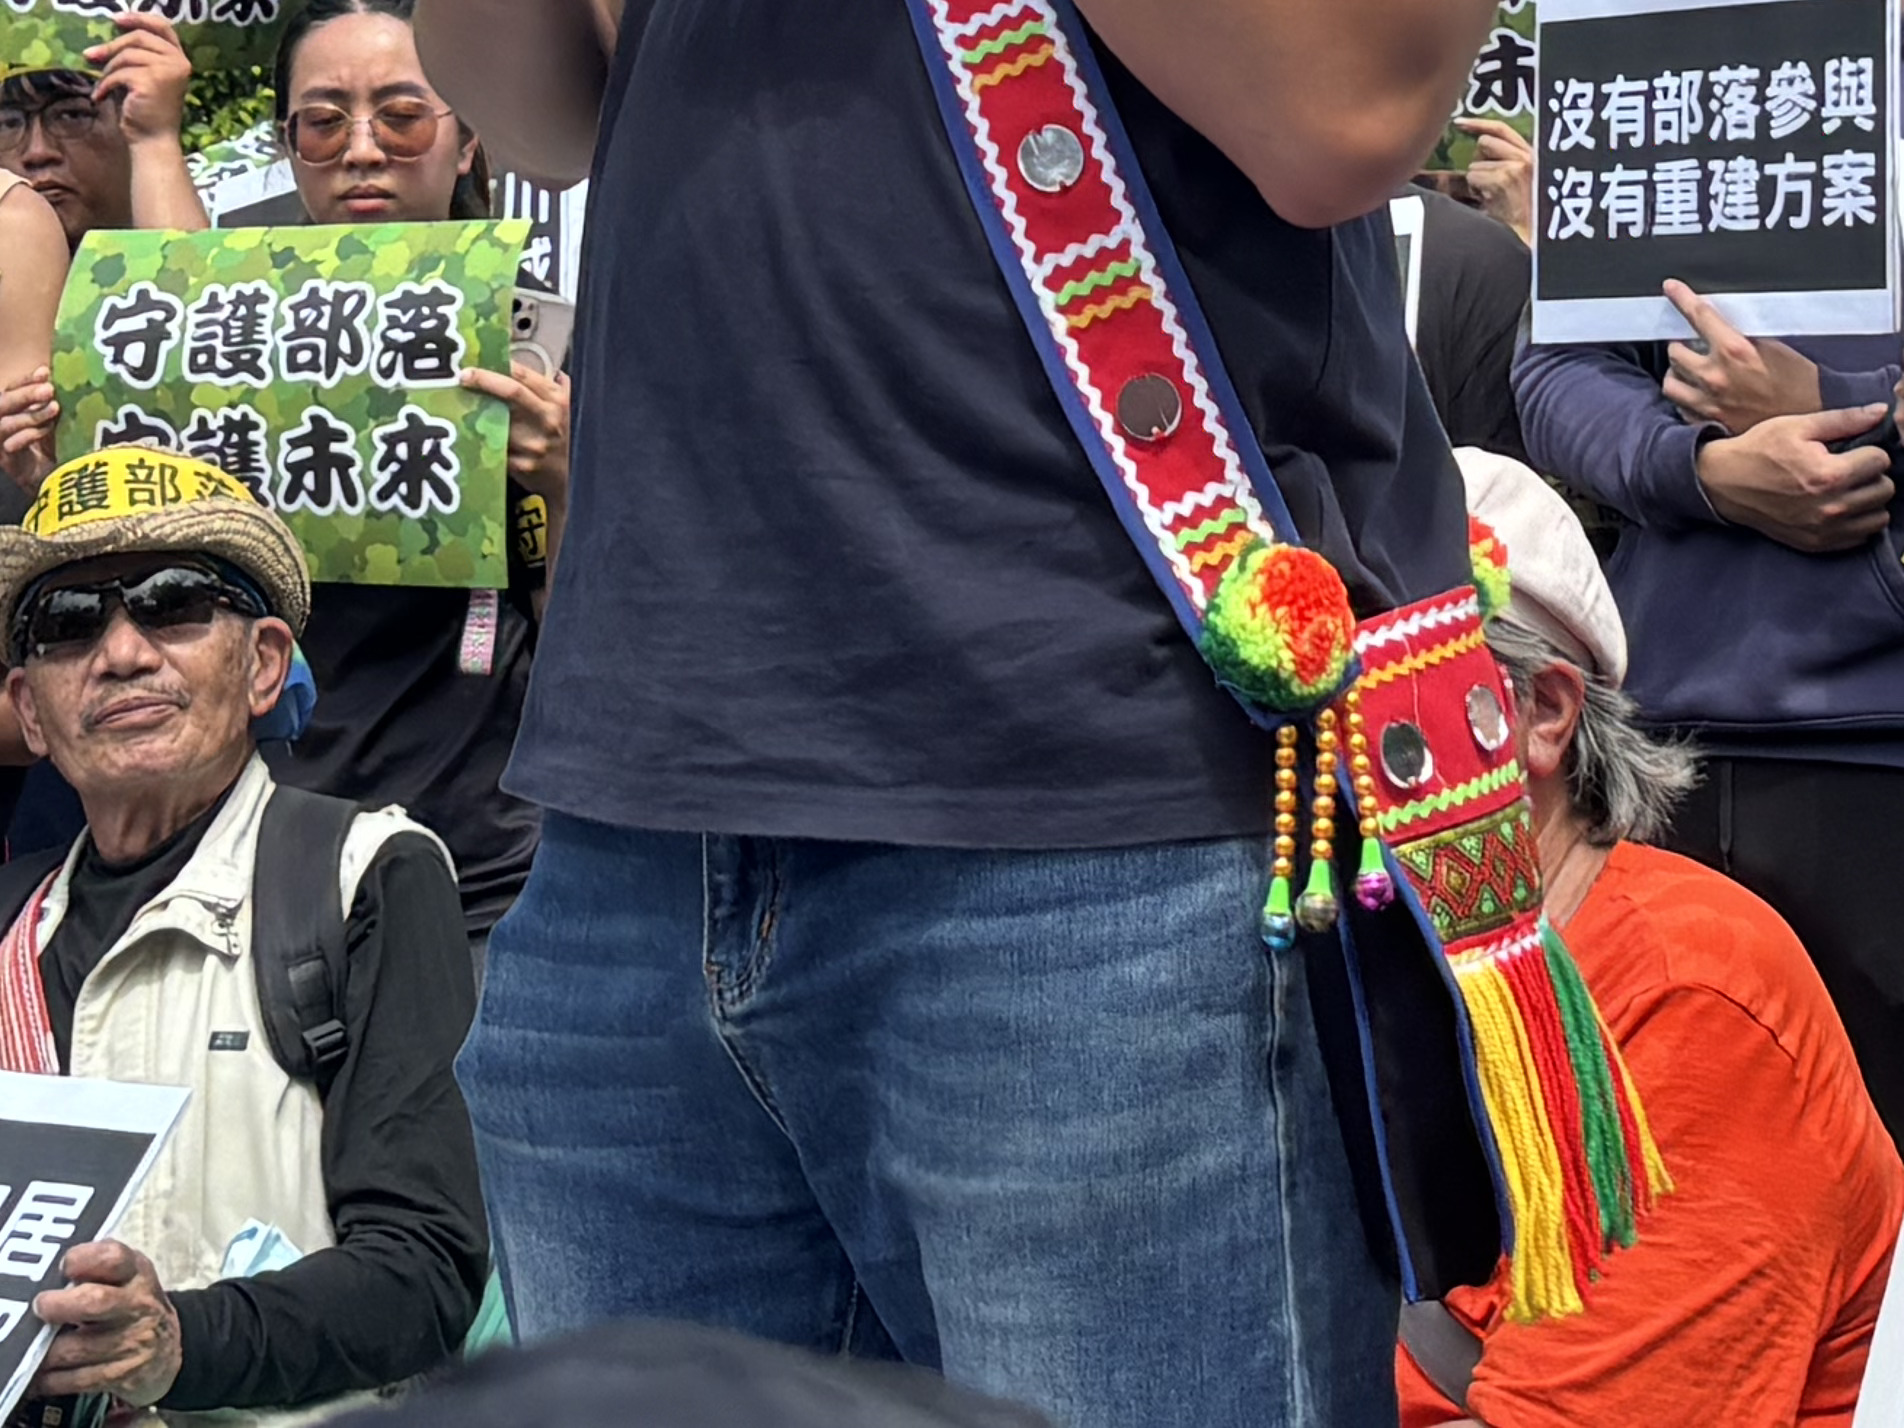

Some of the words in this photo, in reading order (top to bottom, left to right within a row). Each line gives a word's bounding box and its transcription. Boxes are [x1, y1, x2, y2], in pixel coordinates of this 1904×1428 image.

[1547, 56, 1878, 152] 沒有部落參與
[1547, 152, 1879, 241] 沒有重建方案
[104, 286, 459, 382] 守護部落
